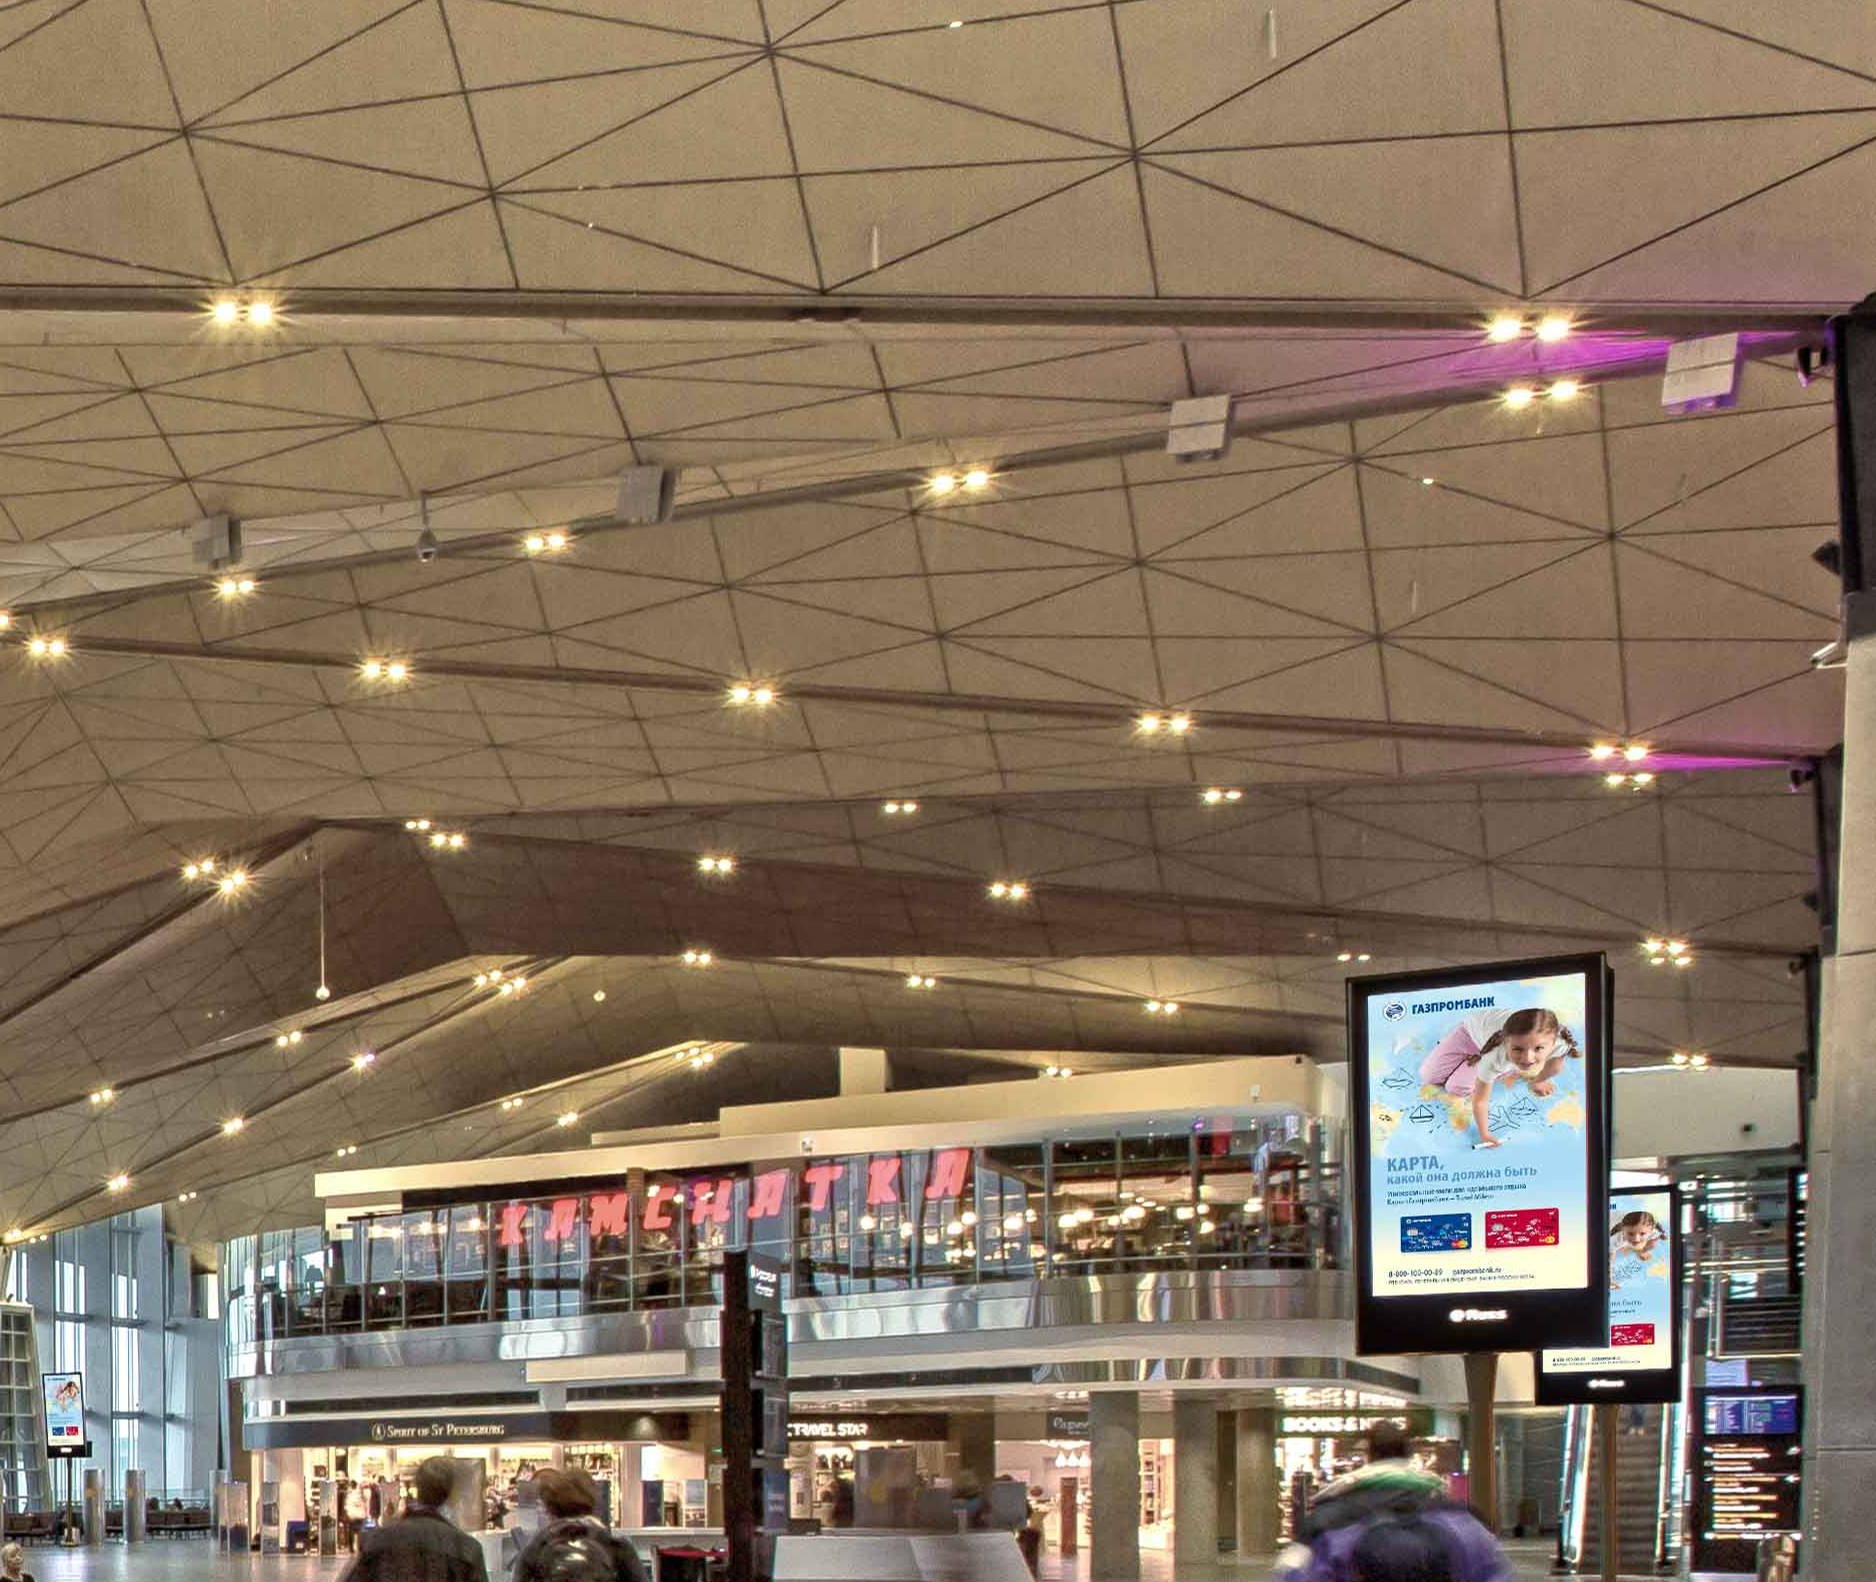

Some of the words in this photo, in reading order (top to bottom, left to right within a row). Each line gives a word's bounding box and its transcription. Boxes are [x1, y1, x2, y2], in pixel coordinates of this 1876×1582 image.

[1411, 996, 1495, 1015] ГАЗПРОМБАНК
[1387, 1155, 1445, 1172] КАРТА,
[1387, 1171, 1423, 1185] какой
[1426, 1174, 1448, 1182] она
[1451, 1169, 1500, 1182] должна
[1504, 1166, 1537, 1177] быть
[792, 1422, 836, 1437] TRAVEL
[837, 1423, 868, 1437] STAR
[1282, 1416, 1344, 1432] BOOKS
